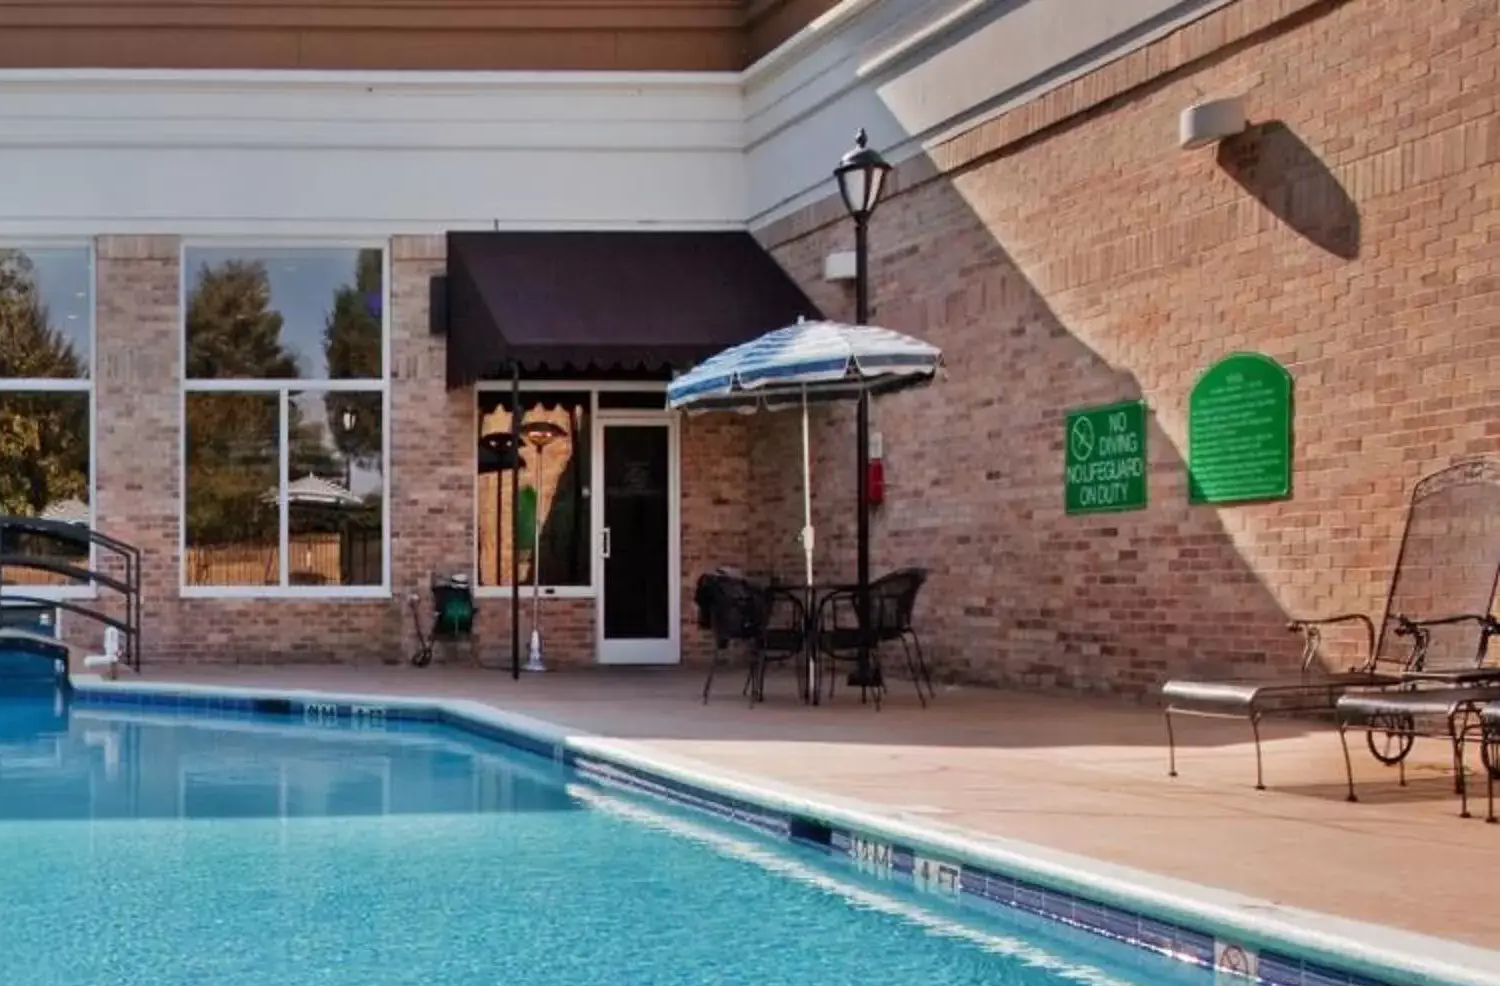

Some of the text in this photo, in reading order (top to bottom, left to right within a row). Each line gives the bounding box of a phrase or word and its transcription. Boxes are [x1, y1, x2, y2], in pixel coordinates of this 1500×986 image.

[1108, 411, 1127, 432] NO
[1099, 432, 1139, 456] DIVING
[1067, 457, 1143, 484] NO LIFEGUARD
[1080, 482, 1129, 506] ON DUTY
